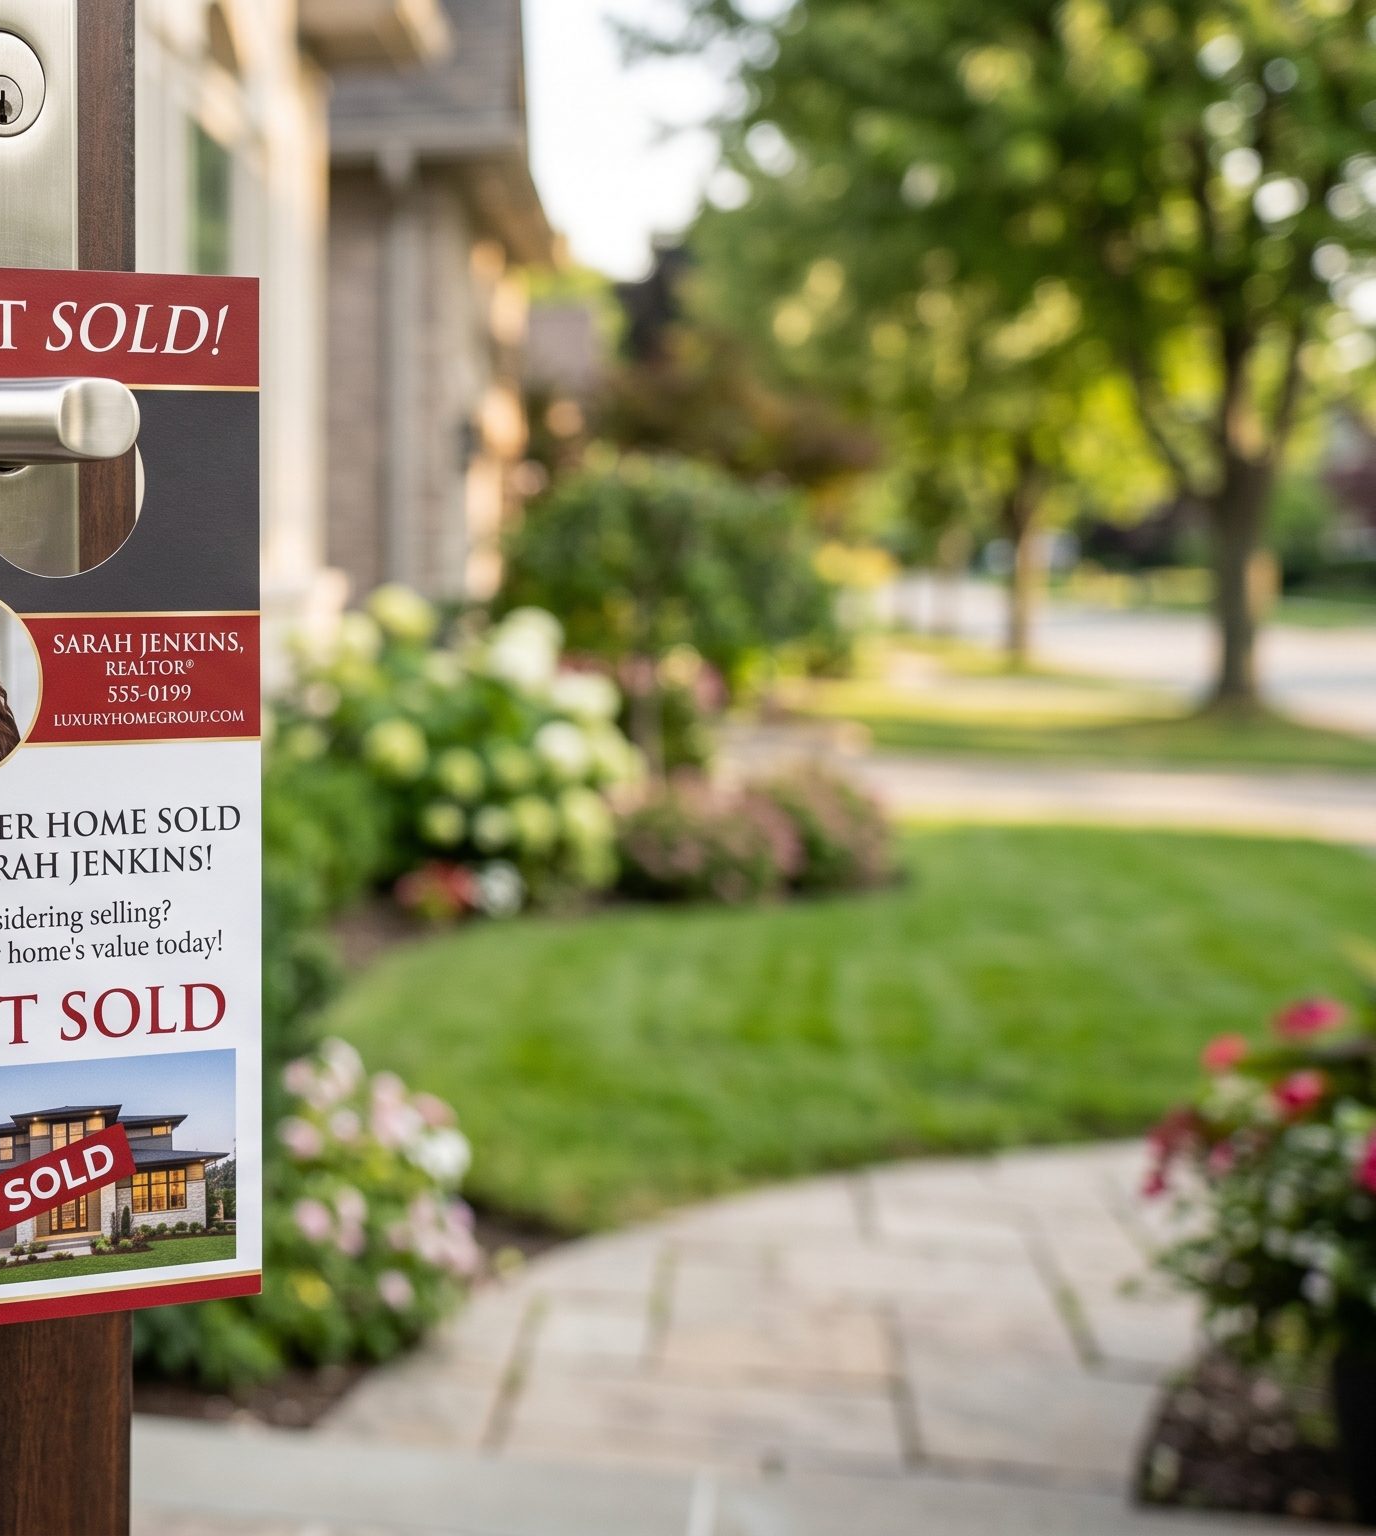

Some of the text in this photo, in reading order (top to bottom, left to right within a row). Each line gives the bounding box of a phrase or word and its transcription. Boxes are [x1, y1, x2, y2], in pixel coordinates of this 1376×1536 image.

[45, 301, 229, 355] SOLD!
[53, 632, 244, 658] SARAH JENKINS,
[107, 684, 191, 702] 555-0199
[53, 709, 245, 726] LUXURYHOMEGROUP.COM
[46, 808, 147, 838] HOME
[157, 805, 241, 834] SOLD
[69, 844, 213, 886] JENKINS!
[90, 899, 172, 930] selling?
[8, 937, 85, 966] home's
[91, 933, 150, 959] value
[155, 929, 223, 961] today!
[59, 982, 226, 1041] SOLD
[3, 1143, 115, 1212] SOLD
